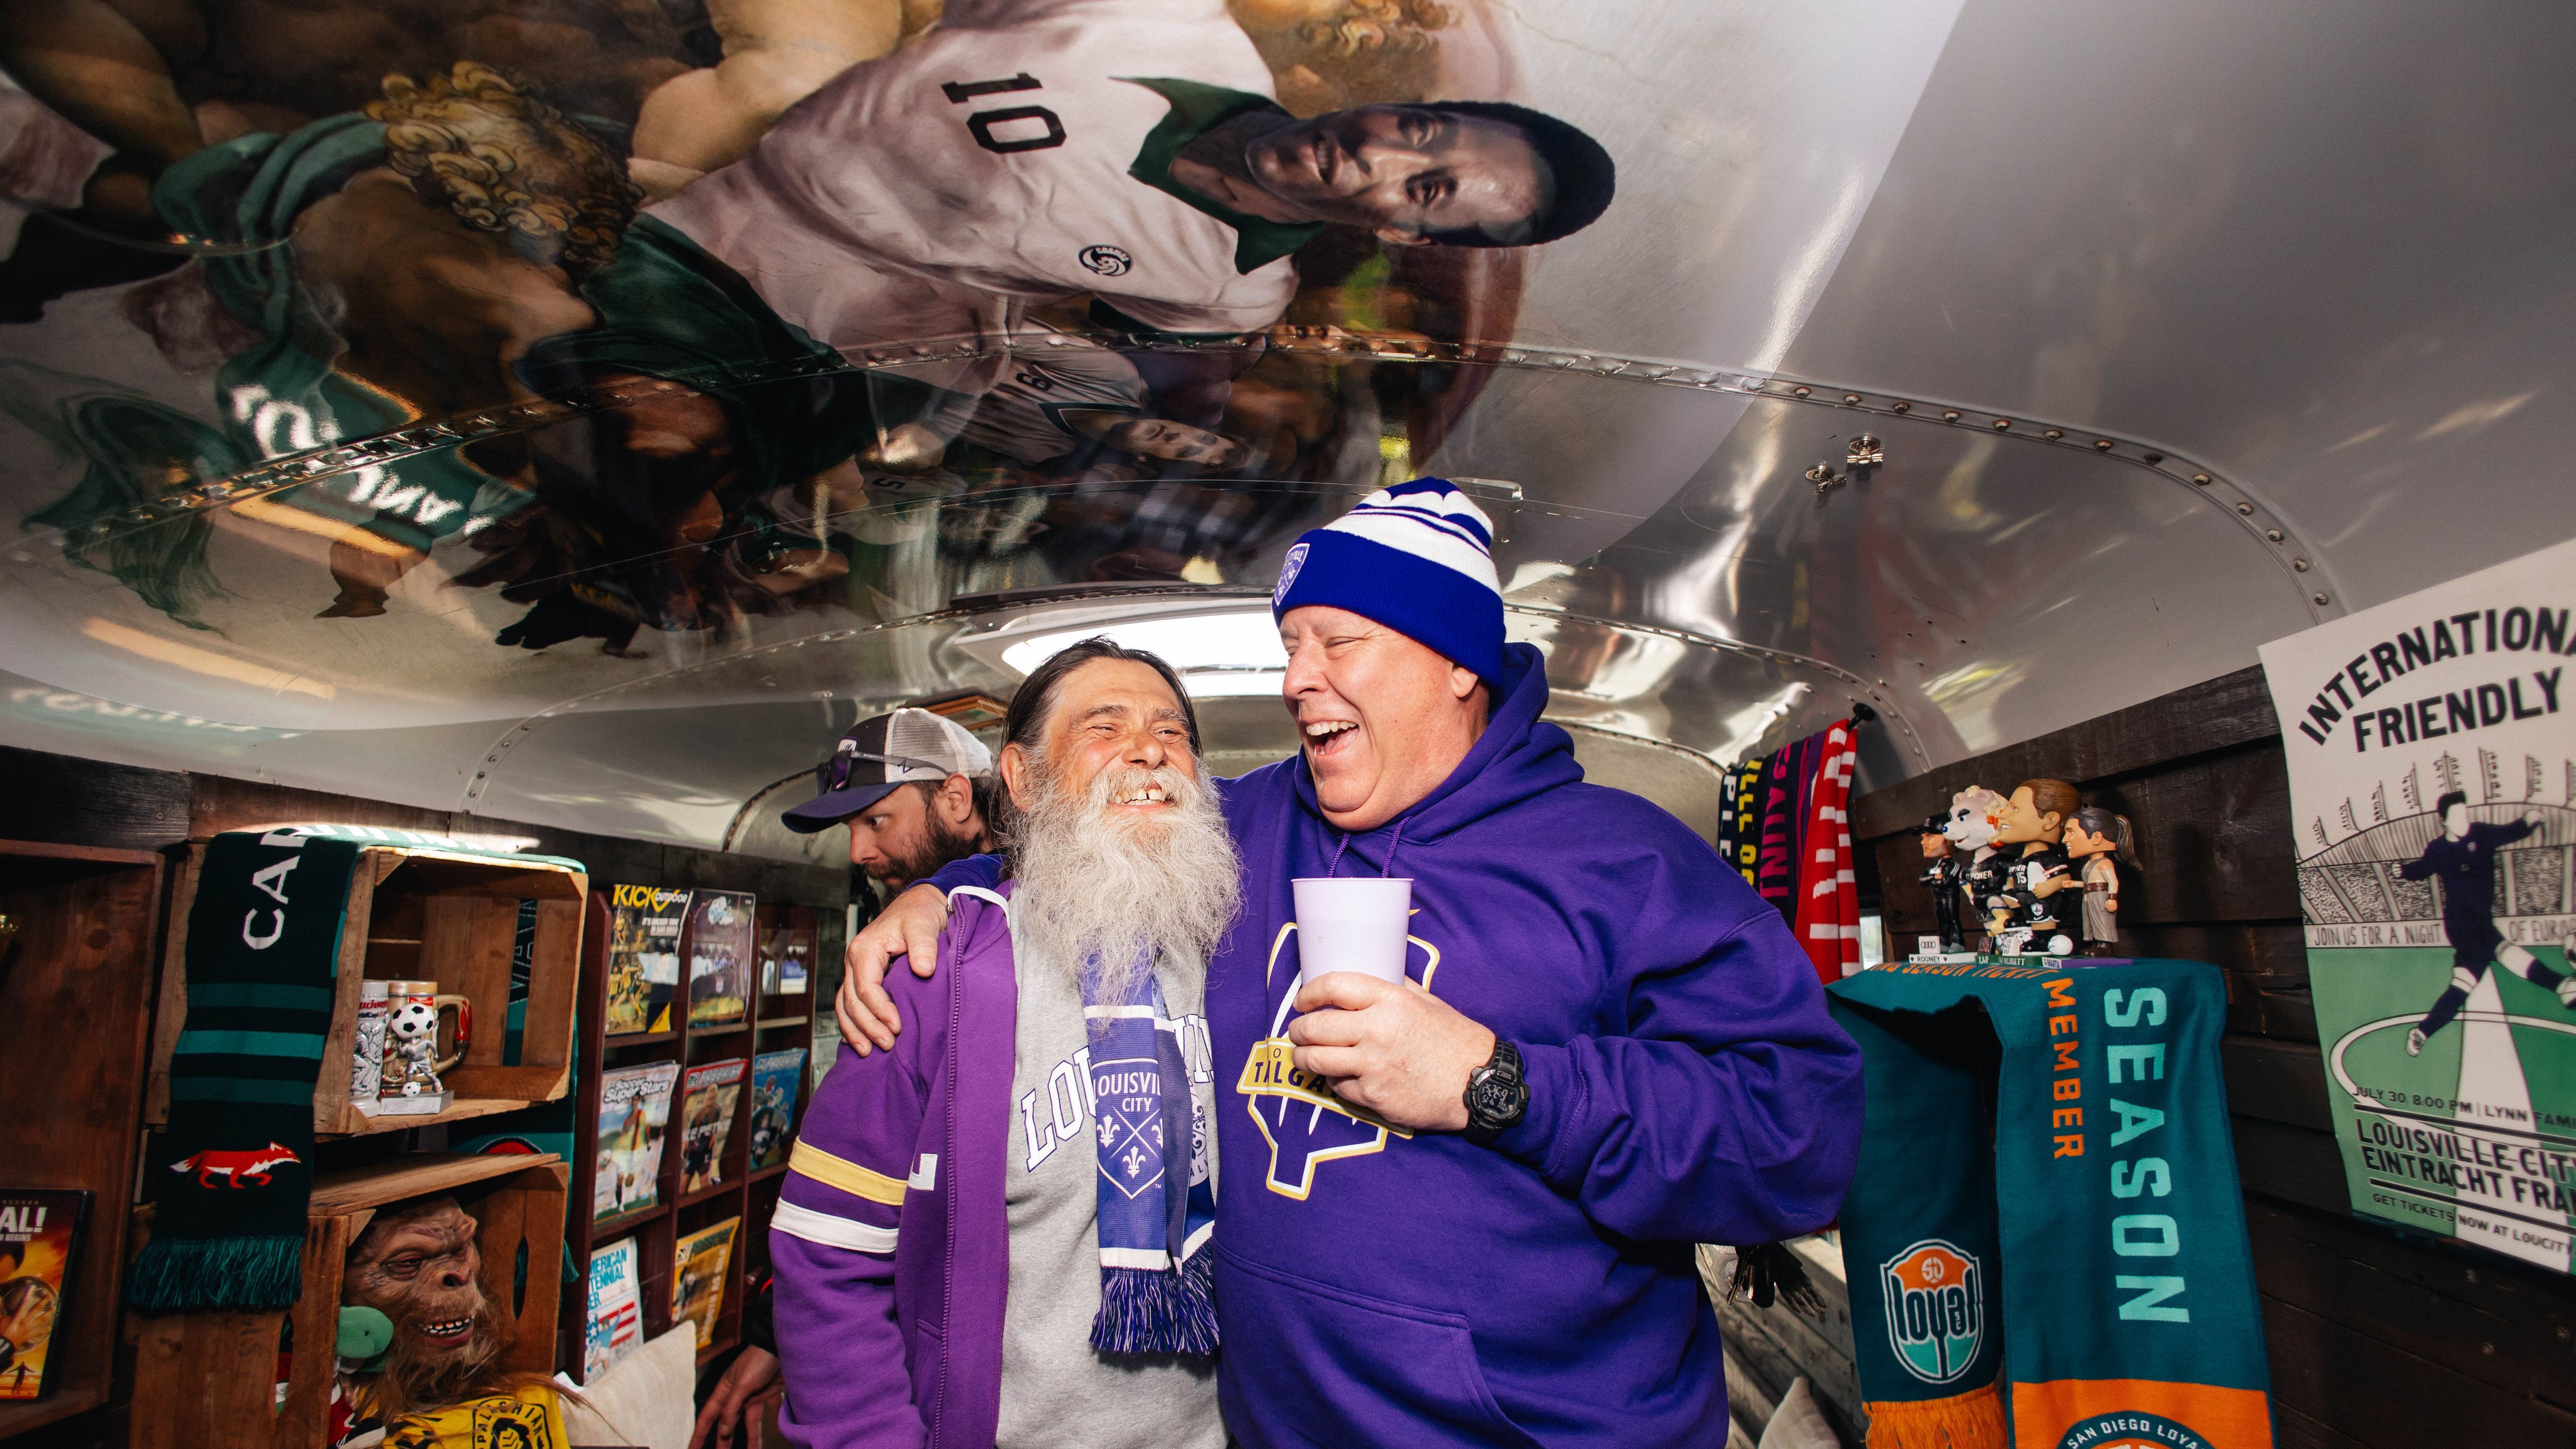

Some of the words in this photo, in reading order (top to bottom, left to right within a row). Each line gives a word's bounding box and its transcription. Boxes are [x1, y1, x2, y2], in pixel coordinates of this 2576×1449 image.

[941, 72, 1067, 154] 10
[2353, 666, 2563, 753] FRIENDLY
[2016, 871, 2027, 884] 15
[613, 884, 664, 911] KICK
[2314, 927, 2340, 946] JOIN
[2344, 926, 2357, 945] US
[2362, 926, 2382, 945] FOR
[2389, 926, 2399, 944] A
[2406, 923, 2441, 945] NIGHT
[2508, 920, 2526, 942] OF
[2041, 977, 2085, 1160] MEMBER
[1122, 1097, 1153, 1111] CITY
[2353, 1086, 2383, 1101] JULY
[2413, 1097, 2444, 1109] 8:00
[2449, 1099, 2471, 1114] PM
[2484, 1104, 2528, 1122] LYNN
[2103, 987, 2190, 1323] SEASON
[2356, 1118, 2514, 1172] LOUISVILLE
[2360, 1145, 2503, 1198] EINTRACHT
[2373, 1193, 2397, 1208] GET
[2400, 1199, 2455, 1223] TICKETS
[2458, 1214, 2489, 1232] NOW
[2493, 1224, 2508, 1236] AT
[5, 1233, 31, 1242] BEGINS
[2067, 1426, 2098, 1449] SAN
[2100, 1418, 2150, 1435] DIEGO
[2157, 1424, 2206, 1449] LOYA
